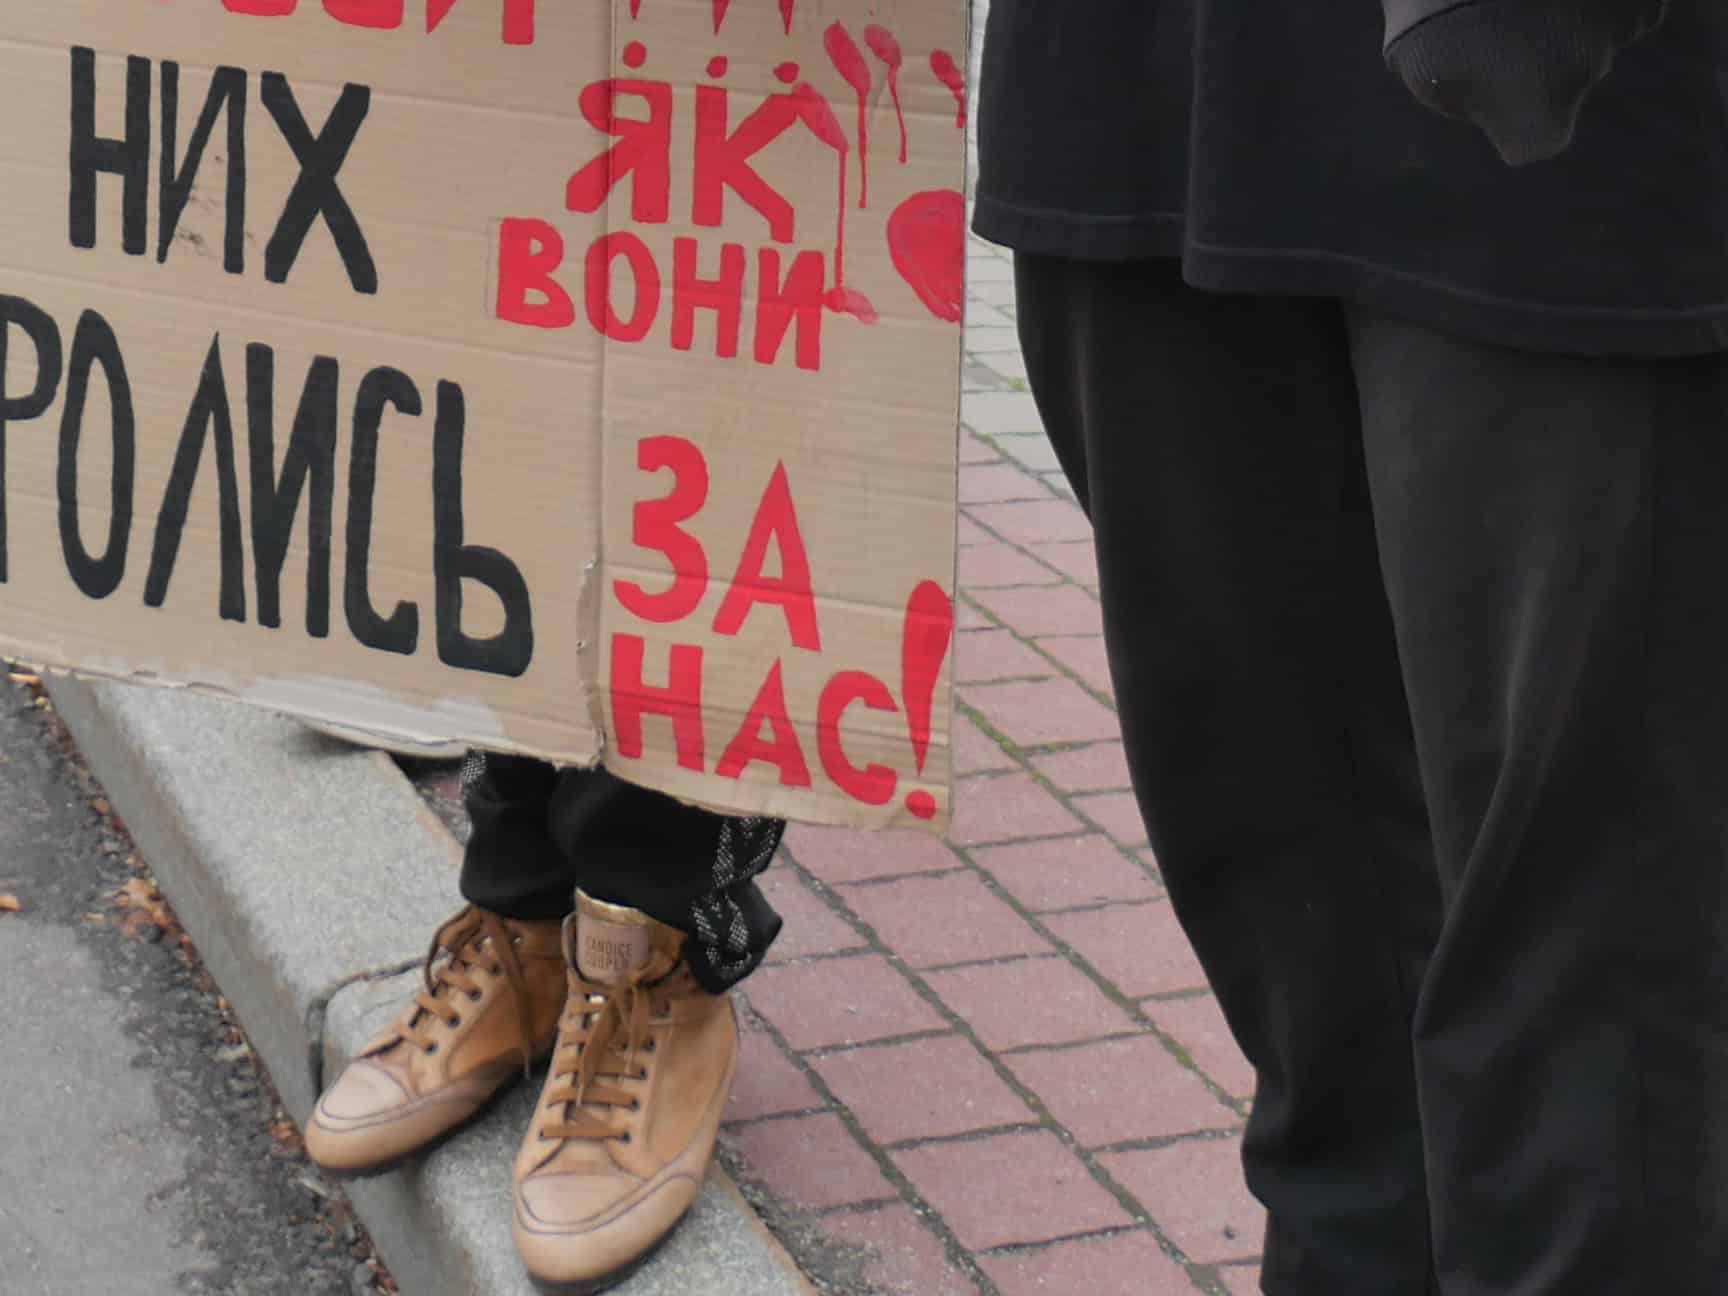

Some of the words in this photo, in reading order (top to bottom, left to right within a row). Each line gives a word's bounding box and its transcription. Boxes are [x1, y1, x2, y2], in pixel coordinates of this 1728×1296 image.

[69, 46, 378, 295] НИХ
[566, 76, 795, 245] ЯК
[495, 216, 826, 373] ВОНИ
[612, 435, 822, 654] ЗА
[610, 572, 956, 820] НАС!
